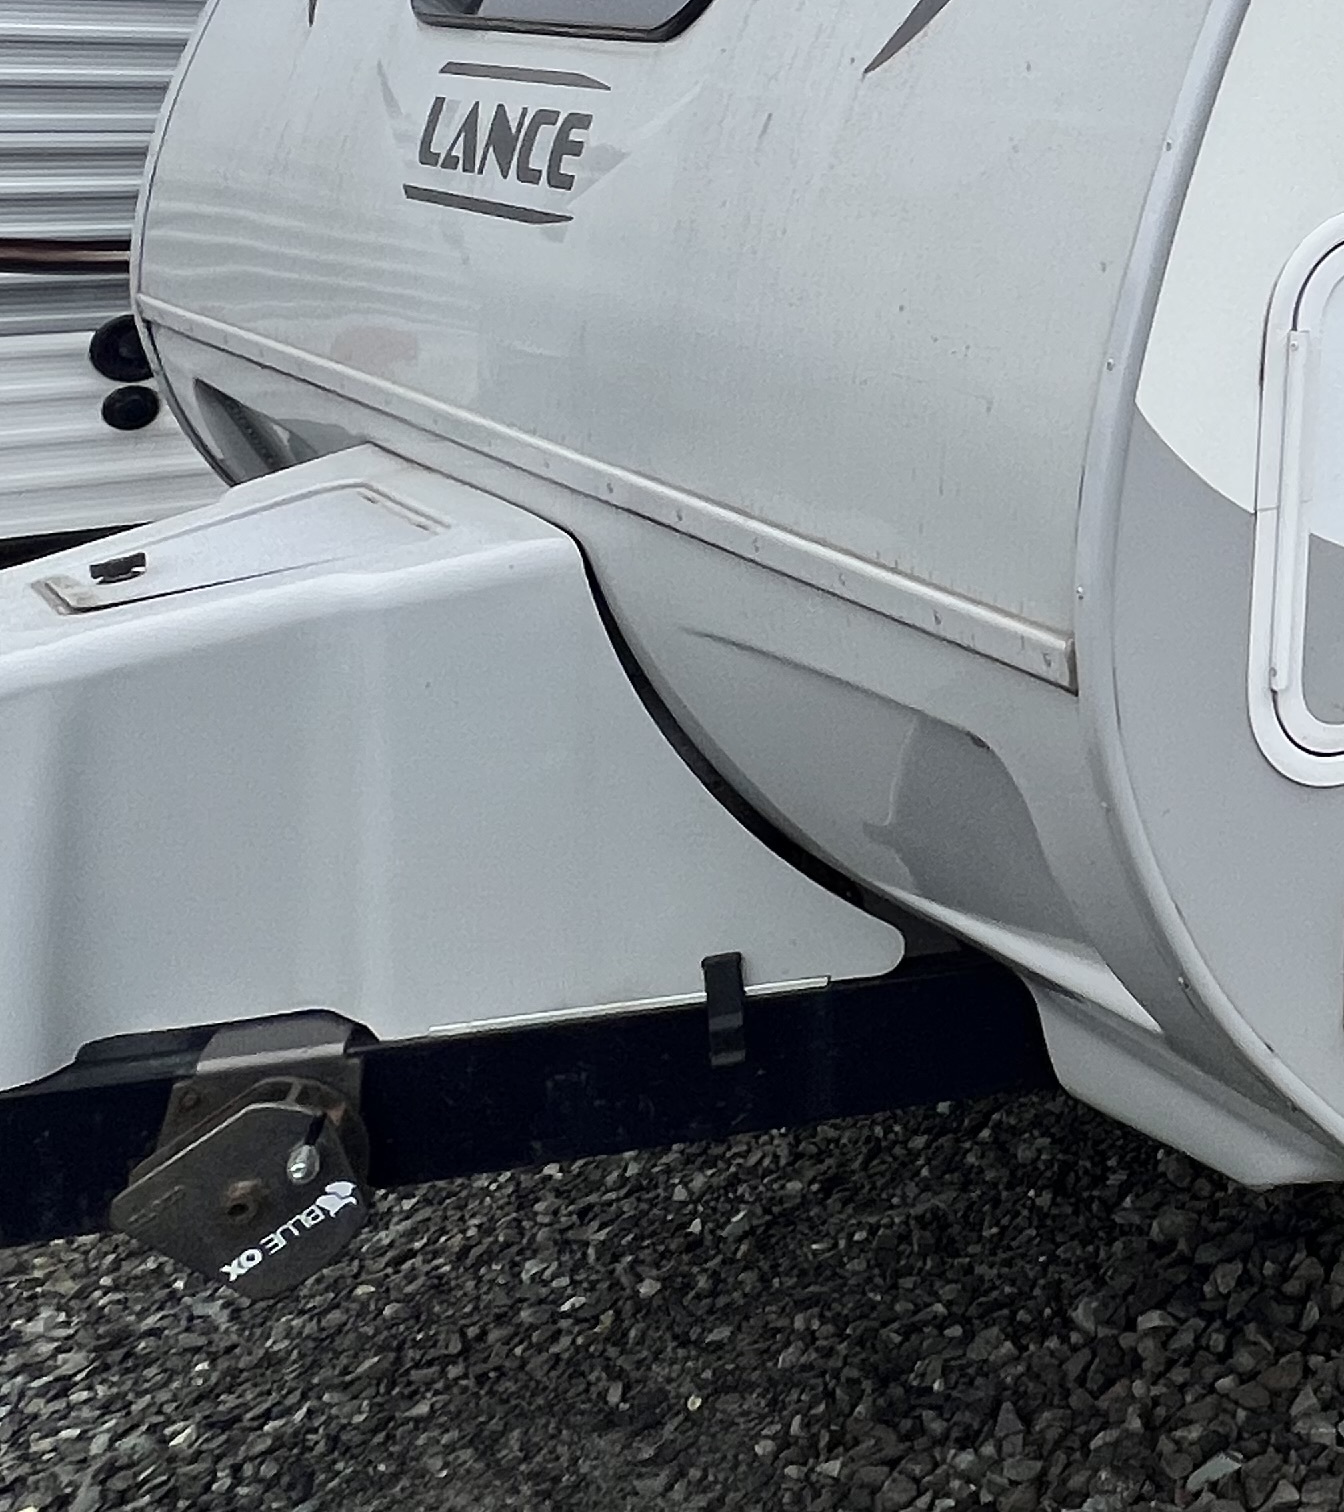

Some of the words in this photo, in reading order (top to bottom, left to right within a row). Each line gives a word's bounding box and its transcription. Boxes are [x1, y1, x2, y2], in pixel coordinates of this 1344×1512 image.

[419, 96, 593, 190] LANCE
[259, 1204, 326, 1255] BLUE
[220, 1249, 263, 1281] OX
